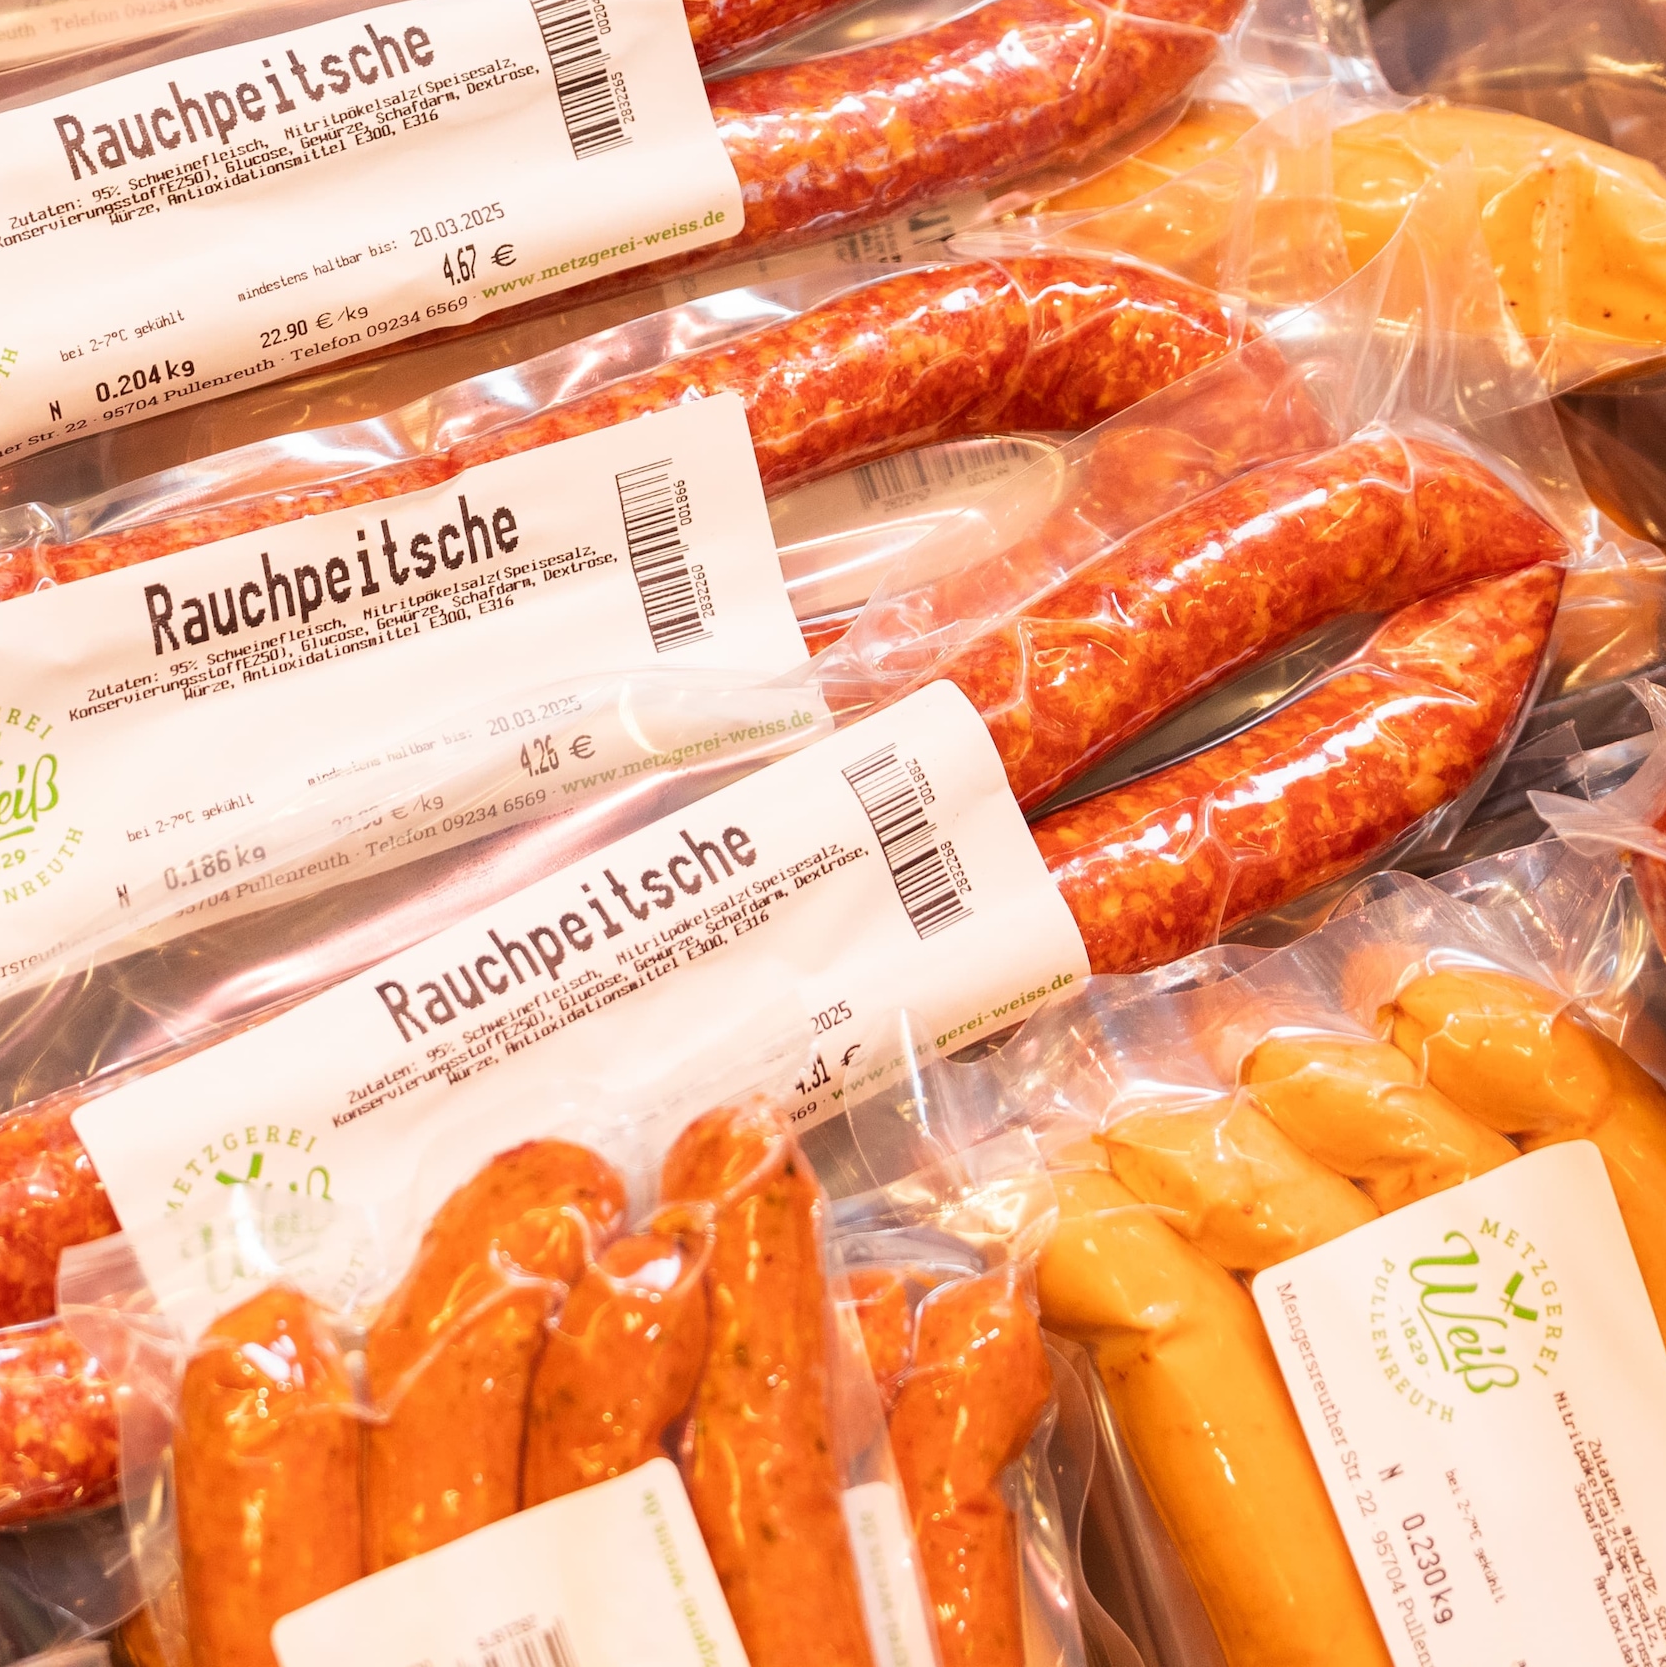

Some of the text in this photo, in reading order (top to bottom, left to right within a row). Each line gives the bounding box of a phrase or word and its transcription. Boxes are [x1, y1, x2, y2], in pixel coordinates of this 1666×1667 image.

[52, 22, 435, 182] Rauchpeitsche
[224, 145, 294, 174] Glucose,
[299, 120, 368, 150] Gewürze,
[374, 90, 461, 124] Schafdarm,
[465, 64, 540, 95] Dextrose,
[610, 70, 636, 125] 2832265
[107, 107, 439, 226] Würze, Antioxidationsmittel E300, E316
[127, 138, 270, 191] Schweinefleisch,
[409, 201, 506, 248] 20.03.2025
[102, 395, 159, 421] 95704
[162, 358, 276, 402] Pullenreuth
[289, 332, 362, 362] Telefon
[365, 309, 421, 338] 09234
[425, 295, 468, 318] 6569
[480, 209, 726, 299] www.metzgerei-weiss.de
[259, 318, 309, 349] 22.90
[442, 243, 477, 286] 4.67
[490, 243, 517, 267] €
[672, 478, 693, 526] 001866
[143, 493, 520, 656] Rauchpeitsche
[690, 563, 716, 619] 2832260
[441, 708, 814, 833] 09234 6569 www.metzgerei-weiss.de
[519, 733, 596, 778] 4.26 €
[904, 757, 936, 806] 001882
[939, 839, 973, 895] 2832268
[373, 825, 757, 1043] Rauchpeitsche
[1407, 1230, 1519, 1395] Weiß
[1479, 1218, 1562, 1376] METZGEREI
